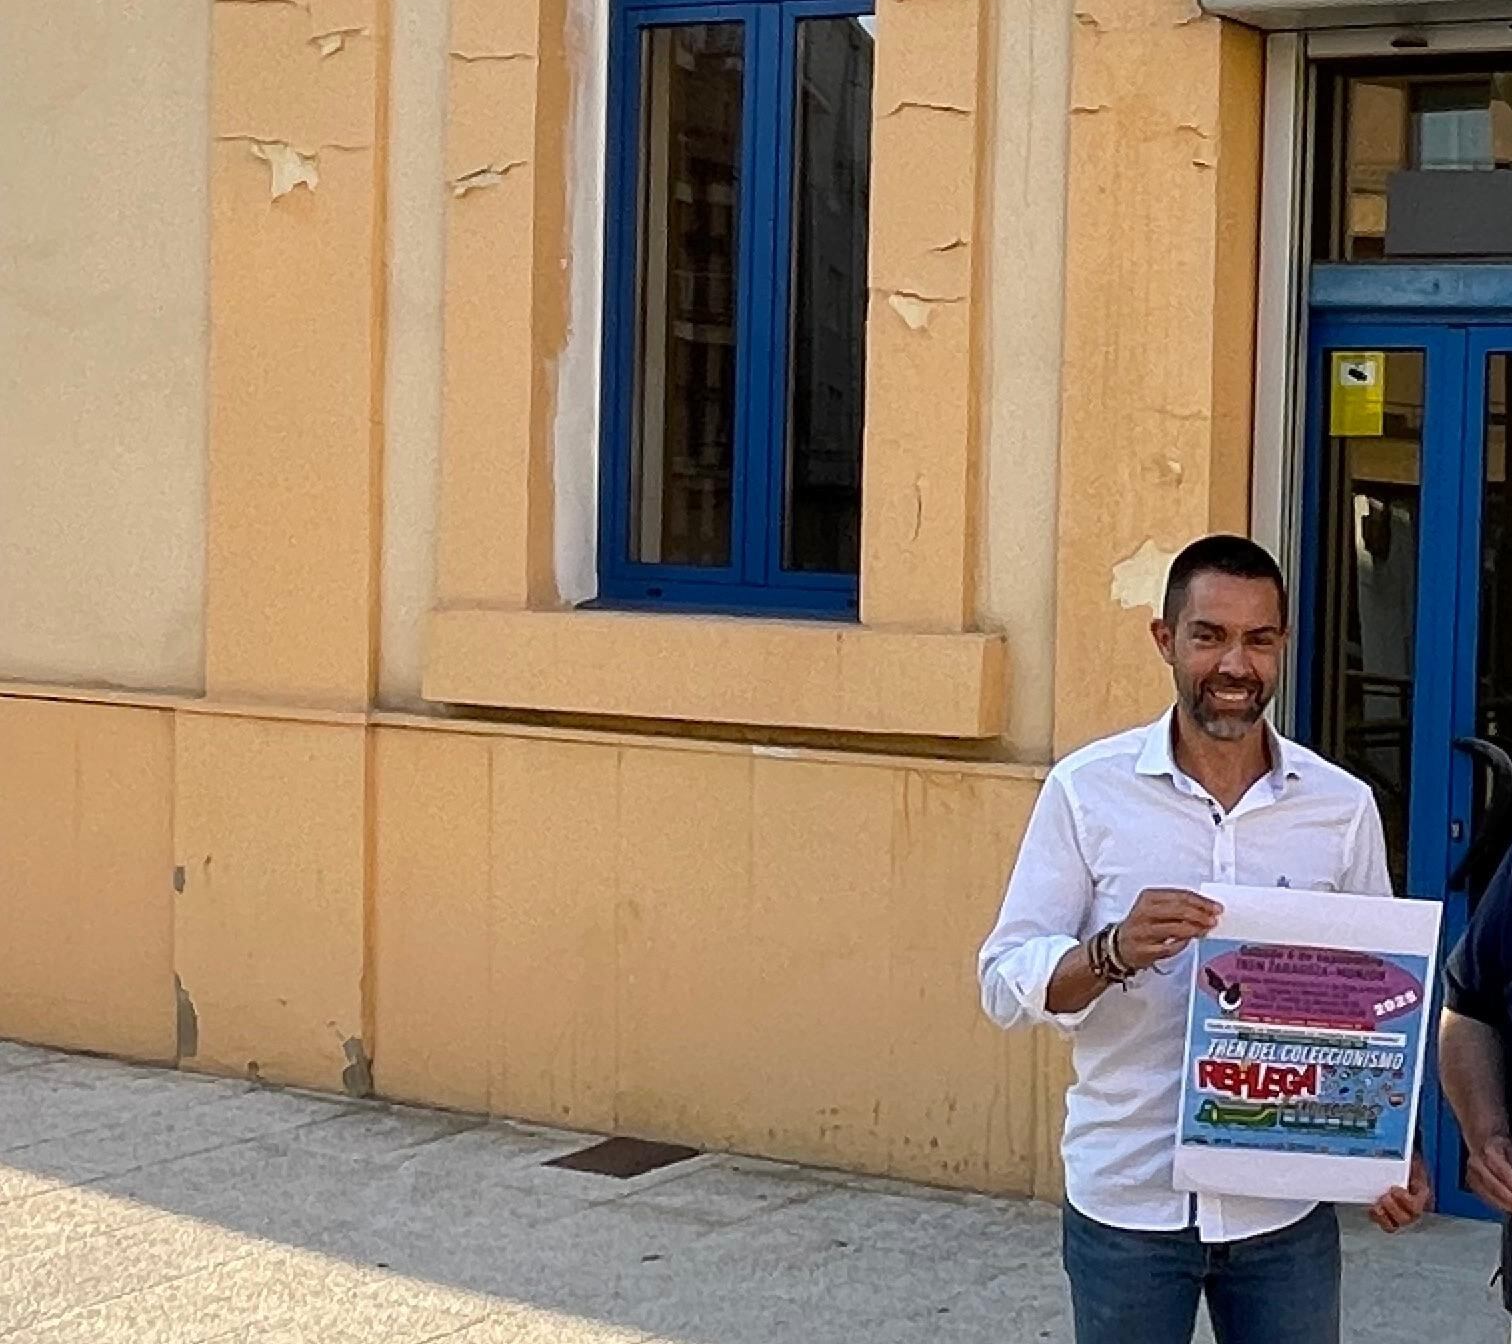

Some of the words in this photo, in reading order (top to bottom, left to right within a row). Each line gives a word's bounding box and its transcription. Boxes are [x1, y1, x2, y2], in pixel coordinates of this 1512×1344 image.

[1208, 1038, 1248, 1058] TREN
[1248, 1040, 1273, 1059] DEL
[1279, 1044, 1404, 1070] COLECCIONISMO
